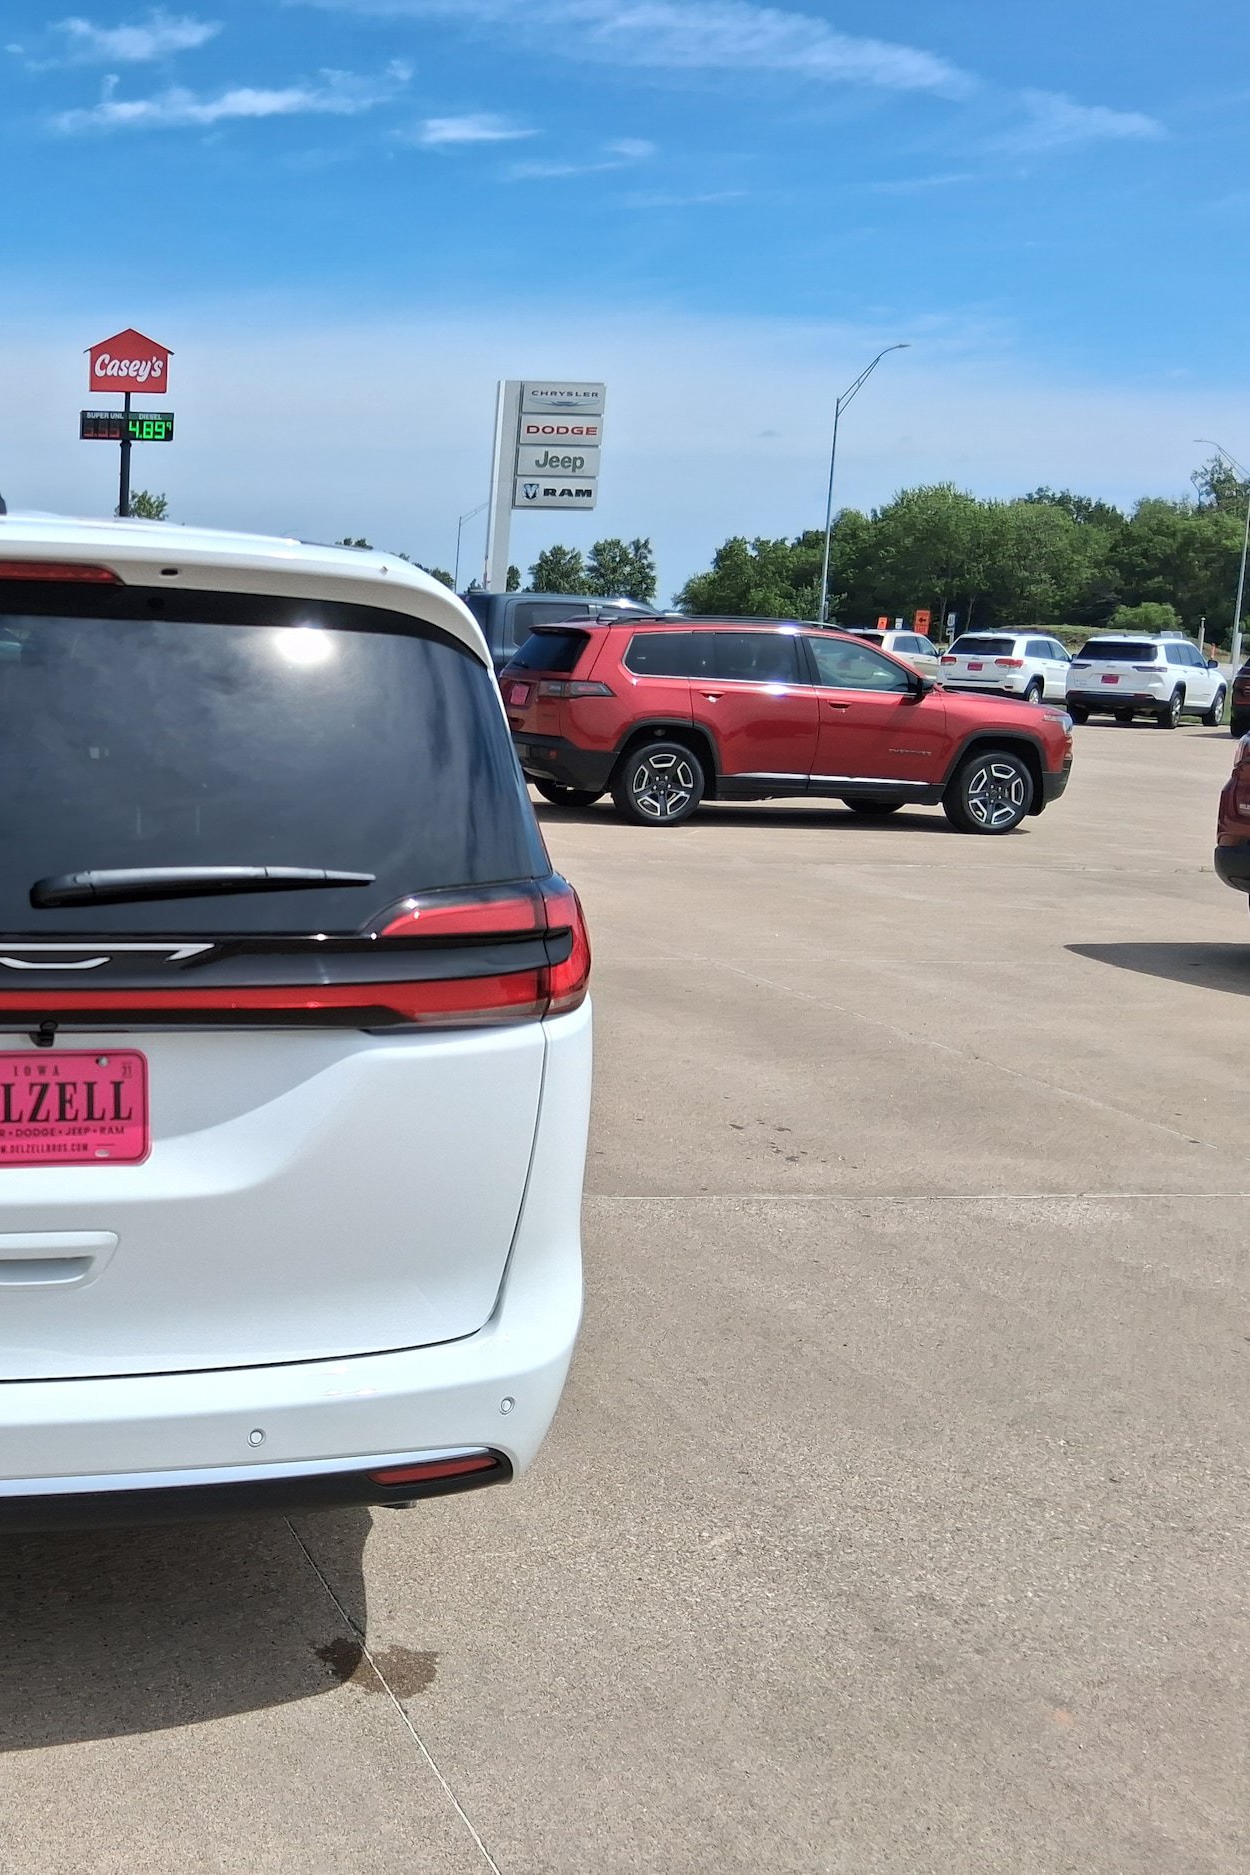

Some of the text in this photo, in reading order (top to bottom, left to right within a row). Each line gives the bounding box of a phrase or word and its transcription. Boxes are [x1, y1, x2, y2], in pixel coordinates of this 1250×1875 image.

[94, 353, 164, 382] Casey's
[531, 390, 599, 398] CHRYSLER
[526, 425, 598, 435] DODGE
[535, 450, 585, 473] Jeep
[543, 488, 592, 498] RAM
[13, 1065, 61, 1077] IOWA
[15, 1128, 57, 1138] DODGE
[65, 1127, 91, 1136] JEEP
[99, 1126, 125, 1135] RAM
